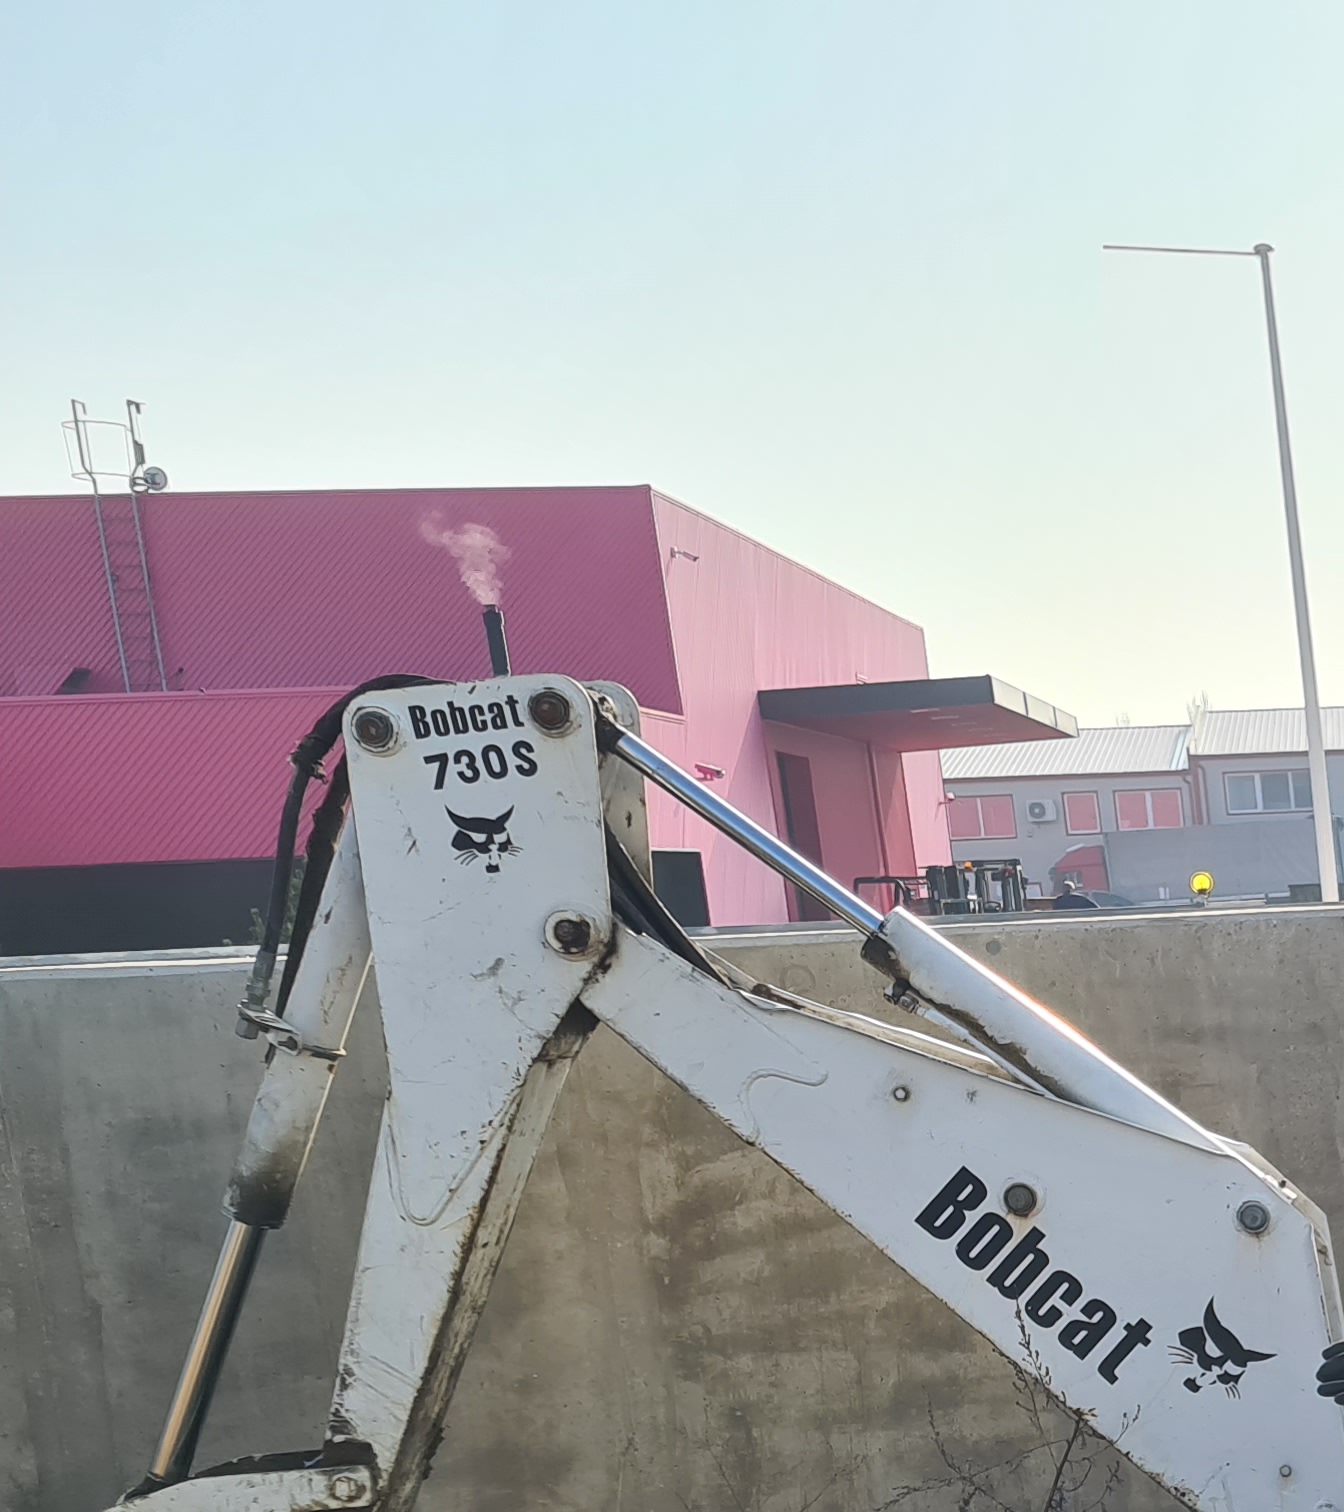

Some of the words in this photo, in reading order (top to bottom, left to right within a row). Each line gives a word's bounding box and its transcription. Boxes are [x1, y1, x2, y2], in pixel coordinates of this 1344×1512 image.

[407, 694, 525, 740] Bobcat
[423, 740, 539, 791] 730S
[913, 1165, 1154, 1386] Bobcat
